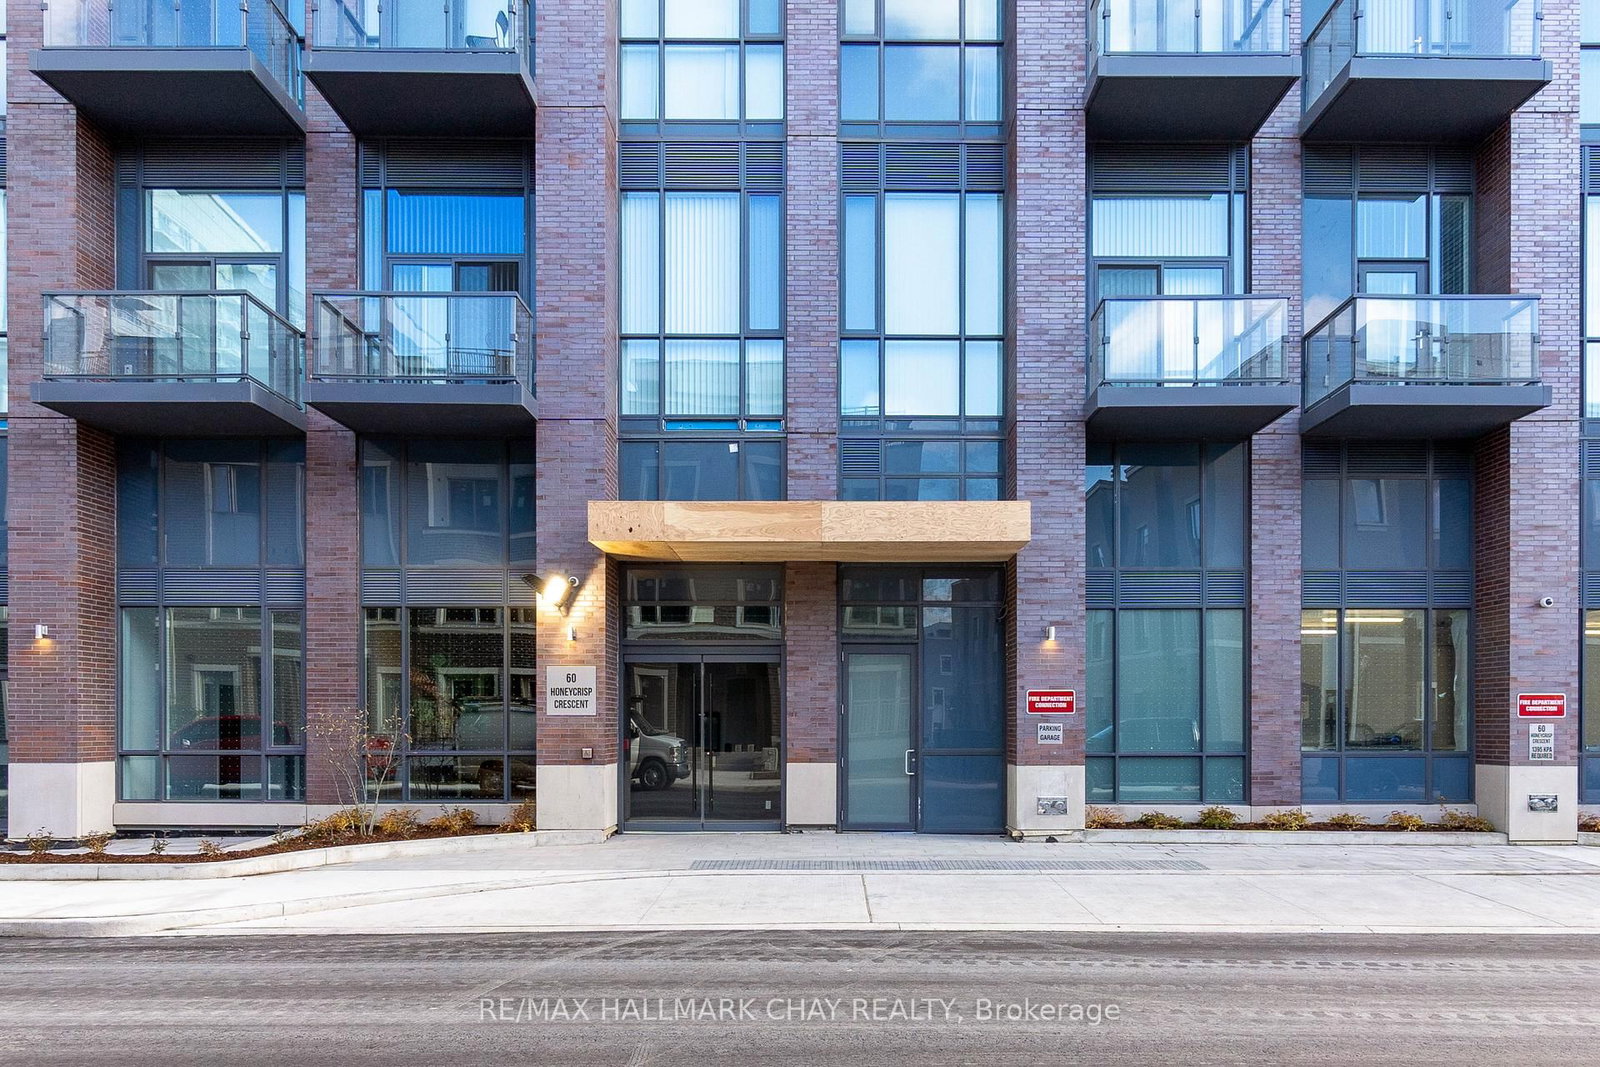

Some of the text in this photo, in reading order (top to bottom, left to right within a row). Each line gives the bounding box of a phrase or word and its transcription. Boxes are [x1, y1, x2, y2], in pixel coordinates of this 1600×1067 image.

[566, 673, 577, 683] 60
[550, 687, 593, 696] HONEYCRISP
[554, 700, 589, 708] CRESCENT
